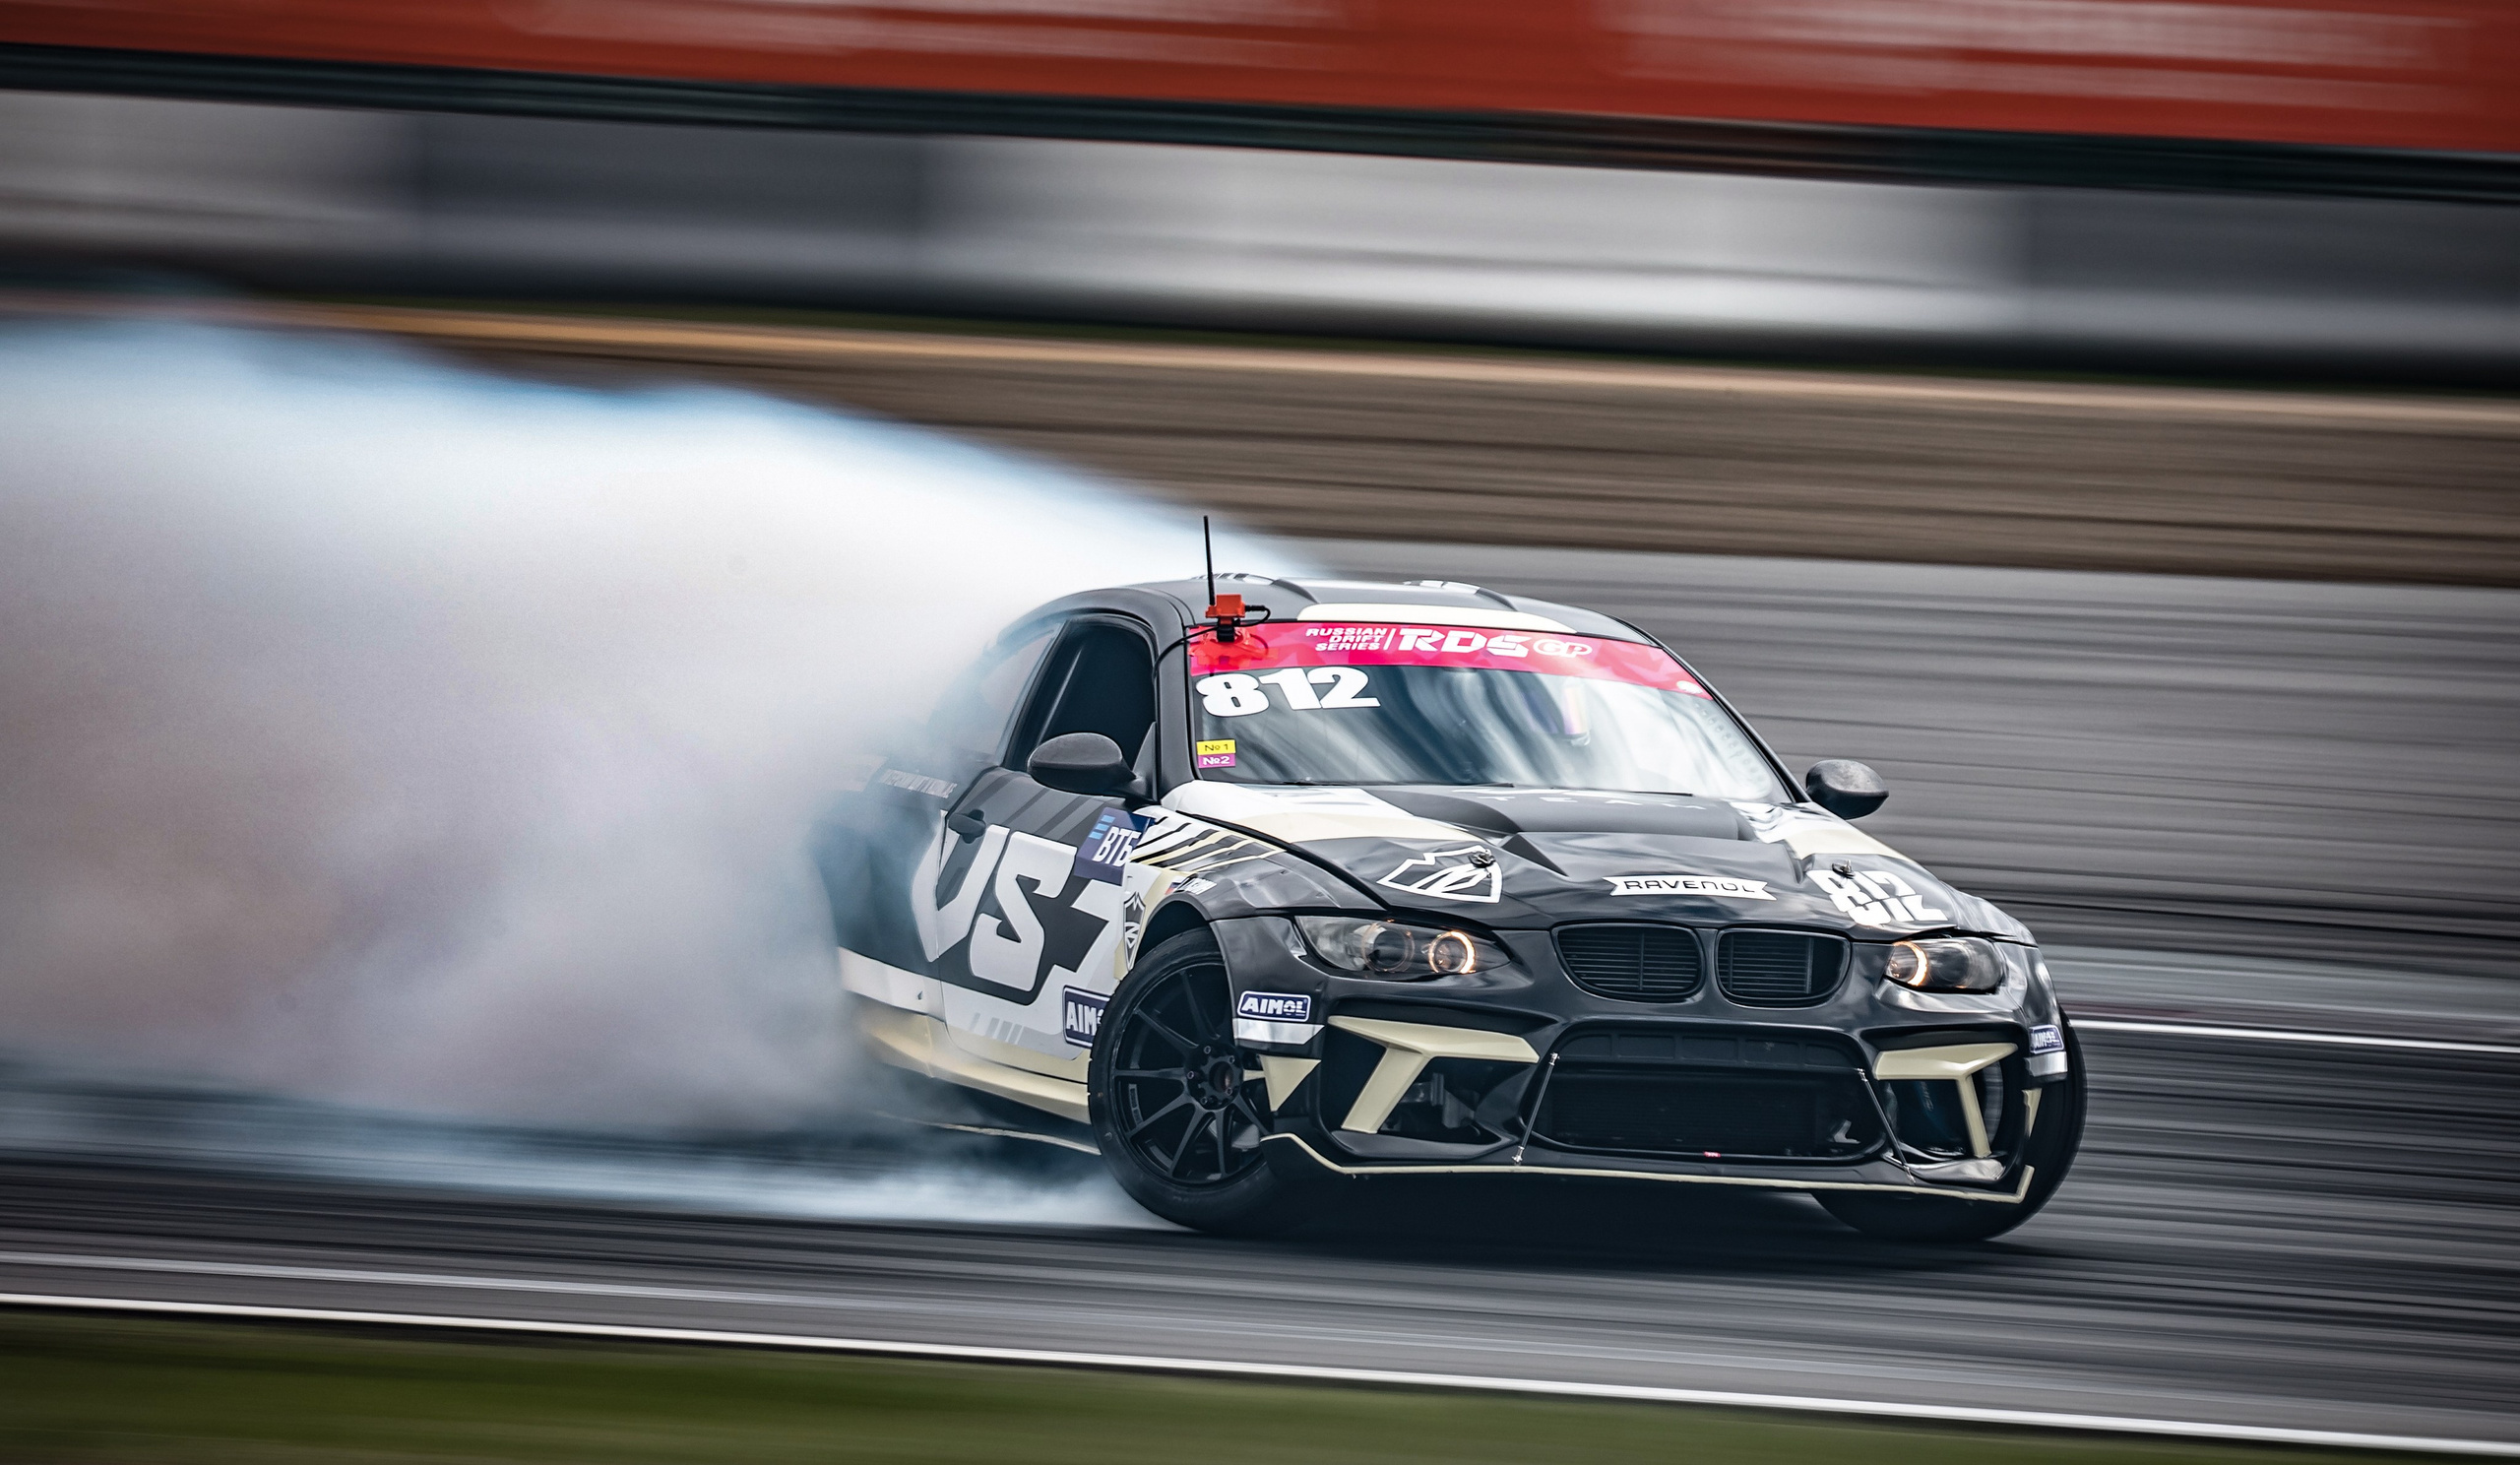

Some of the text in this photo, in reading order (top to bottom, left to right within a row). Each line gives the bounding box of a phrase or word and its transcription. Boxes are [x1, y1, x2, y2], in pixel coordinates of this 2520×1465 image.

[1305, 627, 1387, 637] RUSSIAN
[1315, 641, 1381, 651] SERIES
[1398, 628, 1593, 658] RDS GP
[1196, 667, 1381, 717] 812
[1623, 879, 1756, 893] RAVENOL
[1806, 869, 1948, 926] 812
[1241, 996, 1306, 1017] AIMOL
